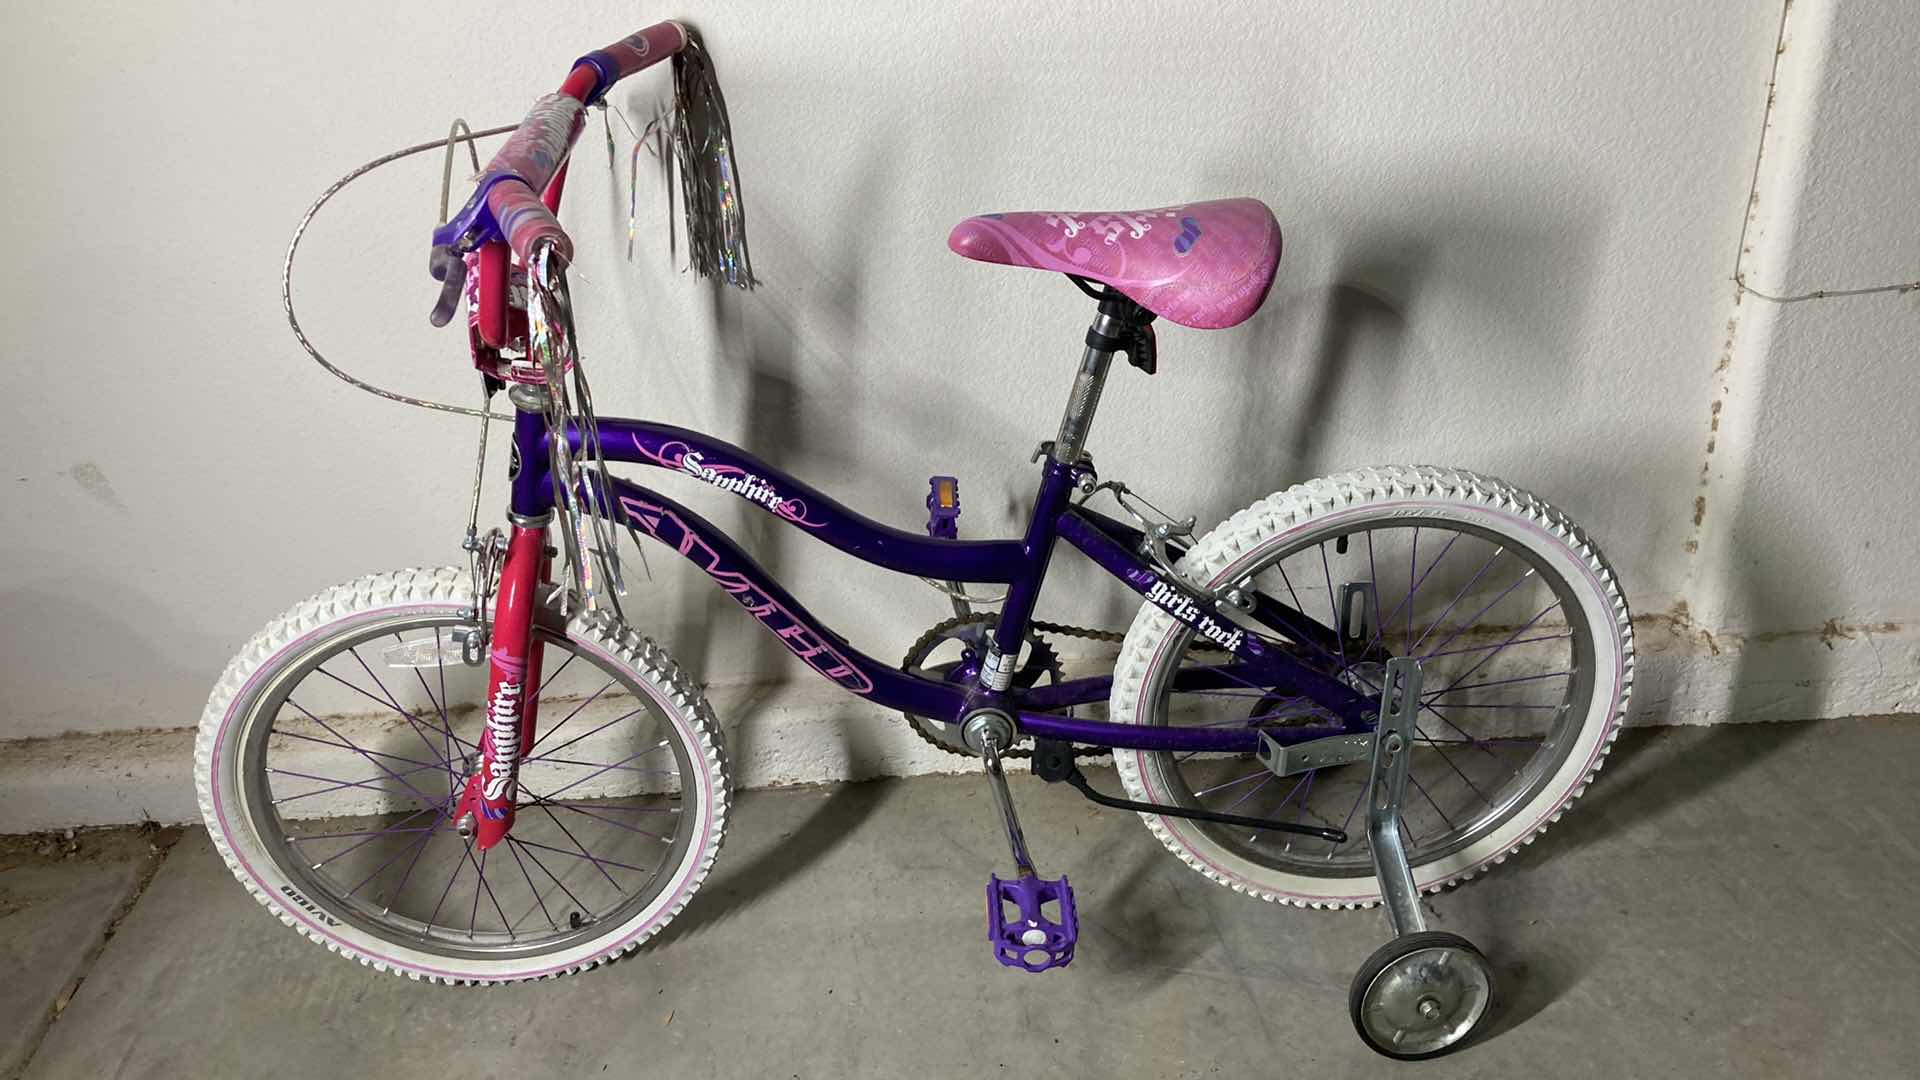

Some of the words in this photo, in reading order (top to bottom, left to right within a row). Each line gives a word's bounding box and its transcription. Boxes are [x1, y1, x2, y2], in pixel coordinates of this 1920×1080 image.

[1144, 580, 1200, 622] girls
[1198, 615, 1244, 651] rock
[482, 681, 522, 801] Sapphire
[281, 885, 342, 927] AVIGO
